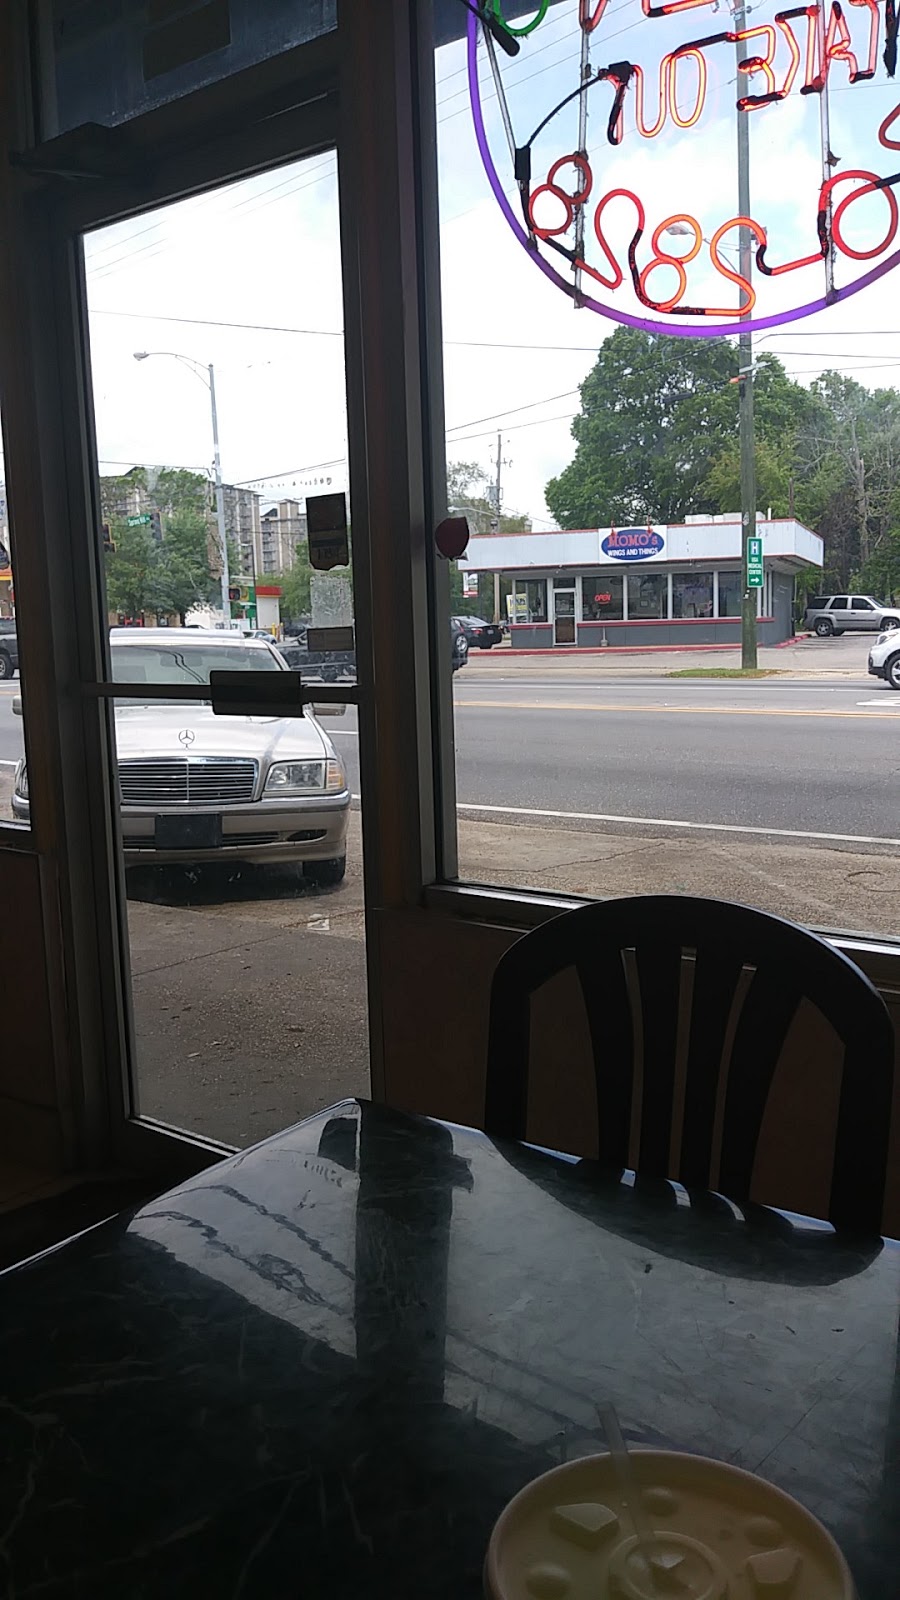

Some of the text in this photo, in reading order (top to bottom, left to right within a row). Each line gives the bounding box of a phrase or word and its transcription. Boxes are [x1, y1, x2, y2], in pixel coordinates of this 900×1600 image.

[638, 547, 658, 555] THINGS
[751, 541, 759, 554] H
[594, 594, 611, 602] OPEN
